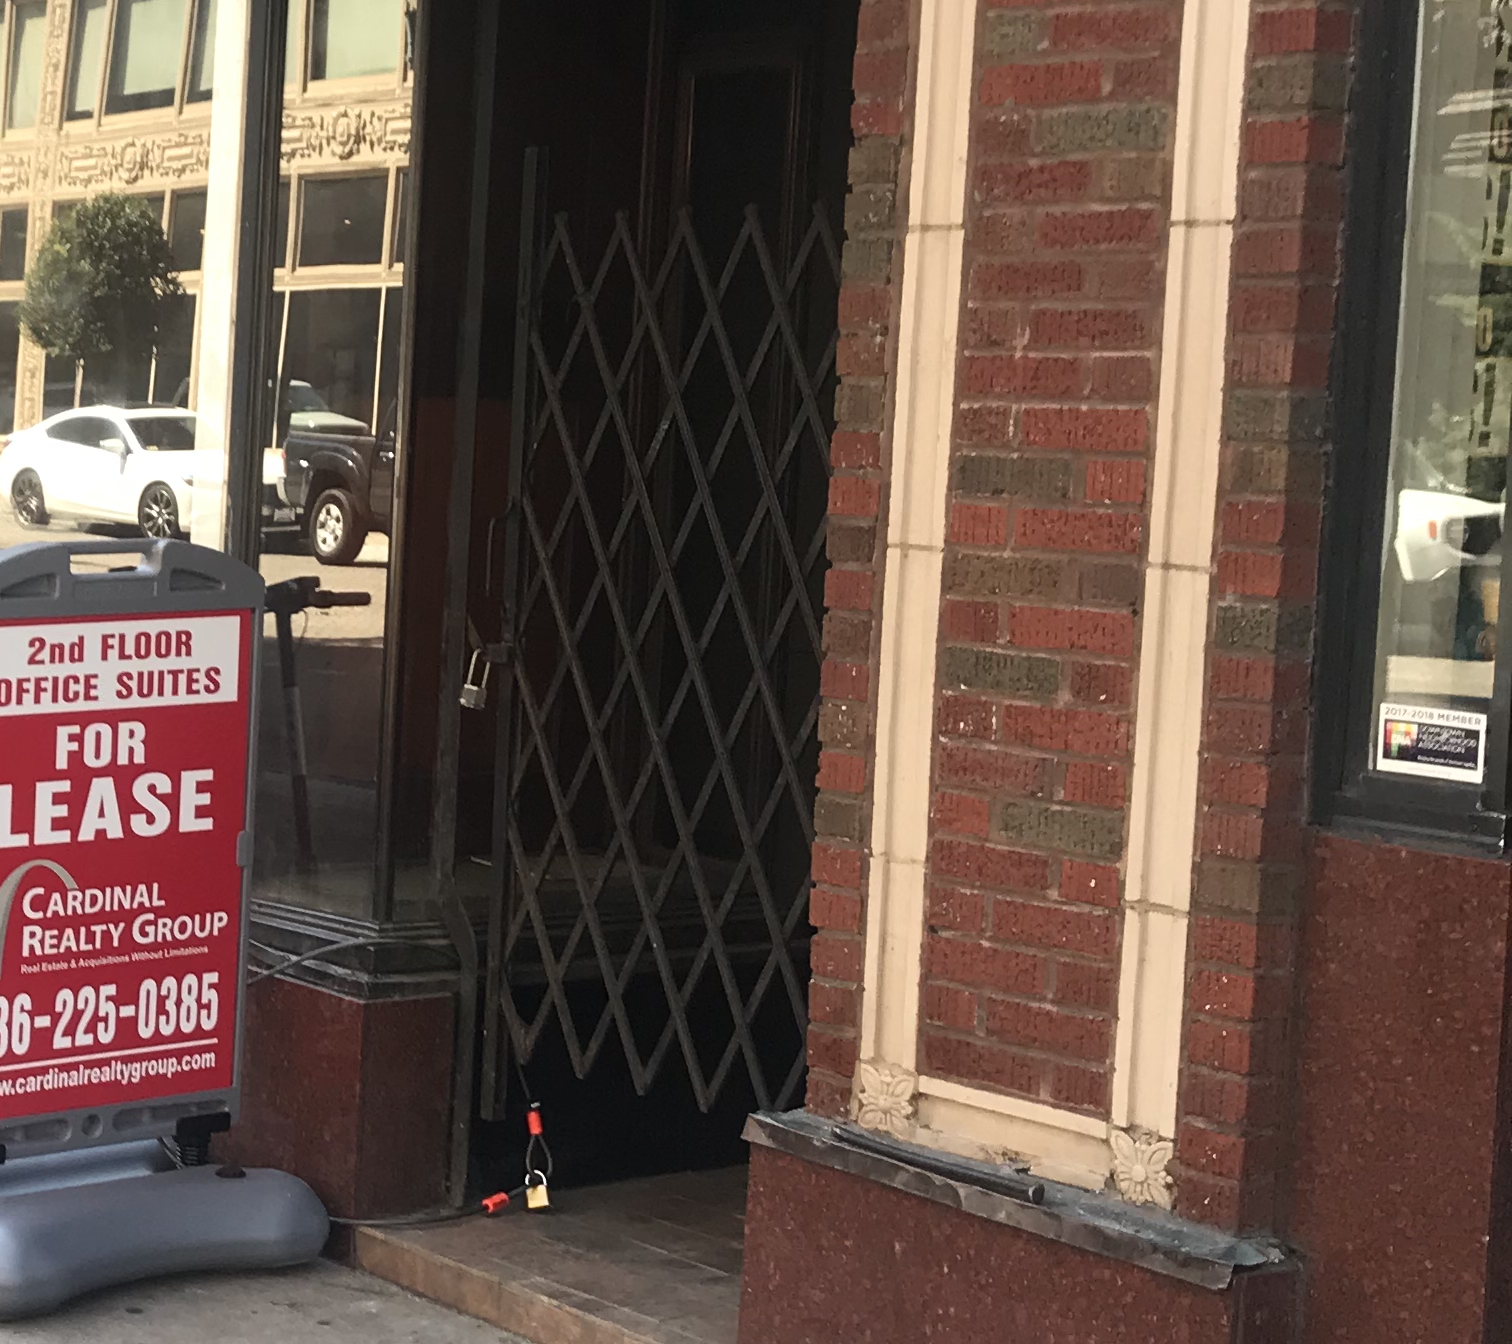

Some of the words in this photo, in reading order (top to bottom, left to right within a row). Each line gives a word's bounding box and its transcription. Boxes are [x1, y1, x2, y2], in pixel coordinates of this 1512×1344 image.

[27, 634, 85, 666] 2nd
[100, 630, 193, 661] FLOOR
[116, 666, 221, 700] SUITES
[1437, 712, 1481, 726] MEMBER
[55, 720, 146, 770] FOR
[22, 882, 165, 919] CARDINAL
[22, 921, 125, 957] REALTY
[131, 911, 229, 946] GROUP
[20, 962, 40, 975] Real
[41, 960, 68, 972] Estate
[69, 958, 78, 969] &
[78, 954, 130, 968] Acquisitions
[131, 948, 164, 962] Without
[164, 945, 209, 958] Limitations
